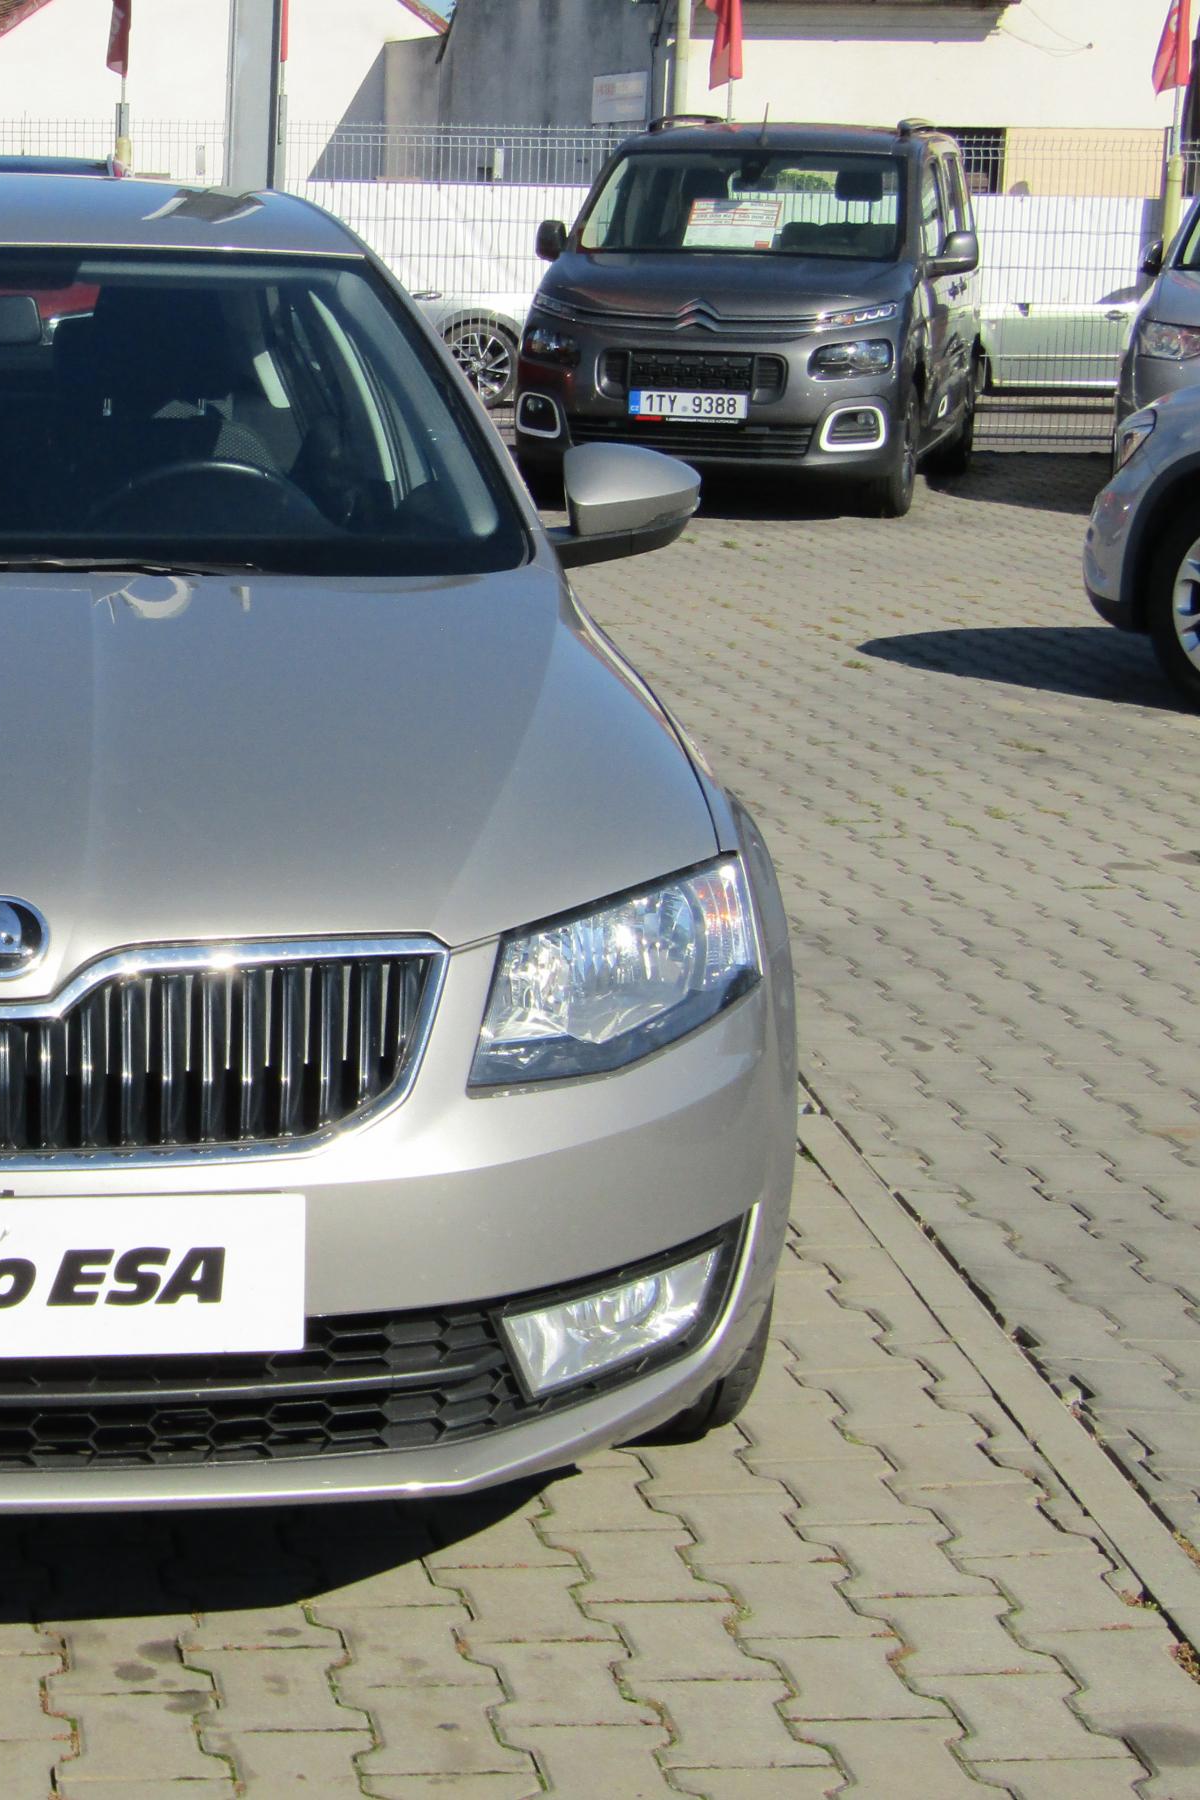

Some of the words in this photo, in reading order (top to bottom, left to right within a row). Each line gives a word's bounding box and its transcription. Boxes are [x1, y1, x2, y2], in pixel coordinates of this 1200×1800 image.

[646, 394, 677, 413] 1TY
[692, 396, 737, 414] 9388
[46, 1246, 226, 1306] ESA
